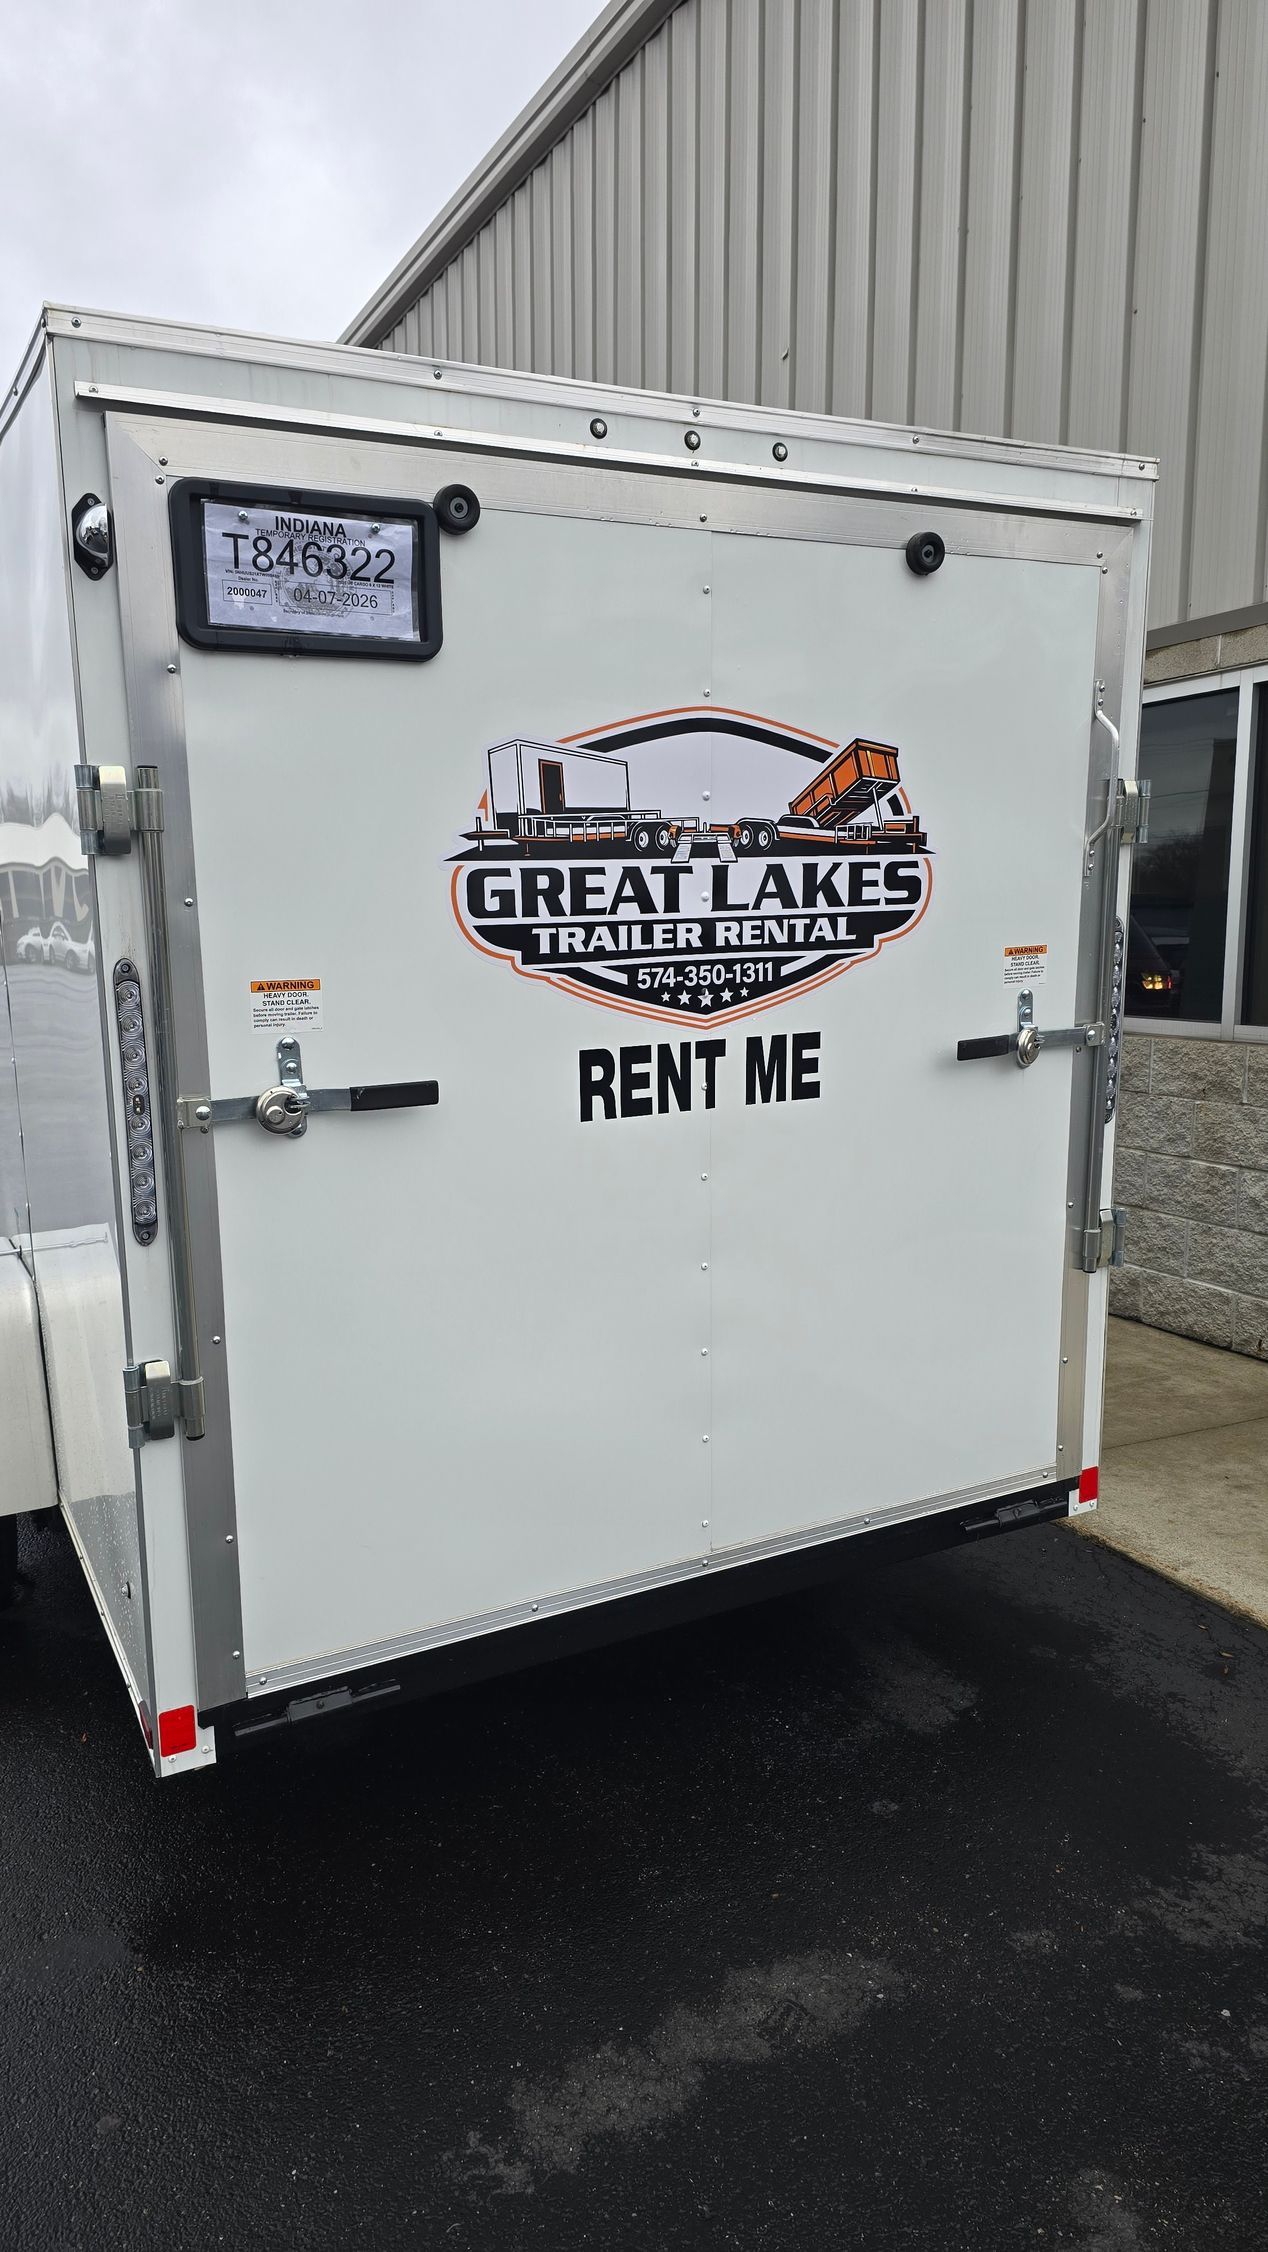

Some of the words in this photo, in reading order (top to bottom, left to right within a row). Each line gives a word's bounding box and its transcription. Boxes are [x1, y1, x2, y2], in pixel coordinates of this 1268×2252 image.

[255, 528, 306, 541] TEMPORARY
[307, 533, 366, 548] REGISTRATION
[275, 516, 347, 538] INDIANA
[221, 532, 396, 585] T846322
[226, 586, 268, 599] 2000047
[293, 587, 378, 609] 04-07-2026
[465, 865, 694, 920] GREAT
[710, 860, 923, 914] LAKES
[531, 921, 702, 955] TRAILER
[714, 916, 857, 948] RENTAL
[1014, 945, 1044, 955] WARNING
[266, 981, 314, 991] WARNING
[636, 961, 774, 990] 574-350-1311
[578, 1039, 727, 1123] RENT
[745, 1032, 822, 1106] ME
